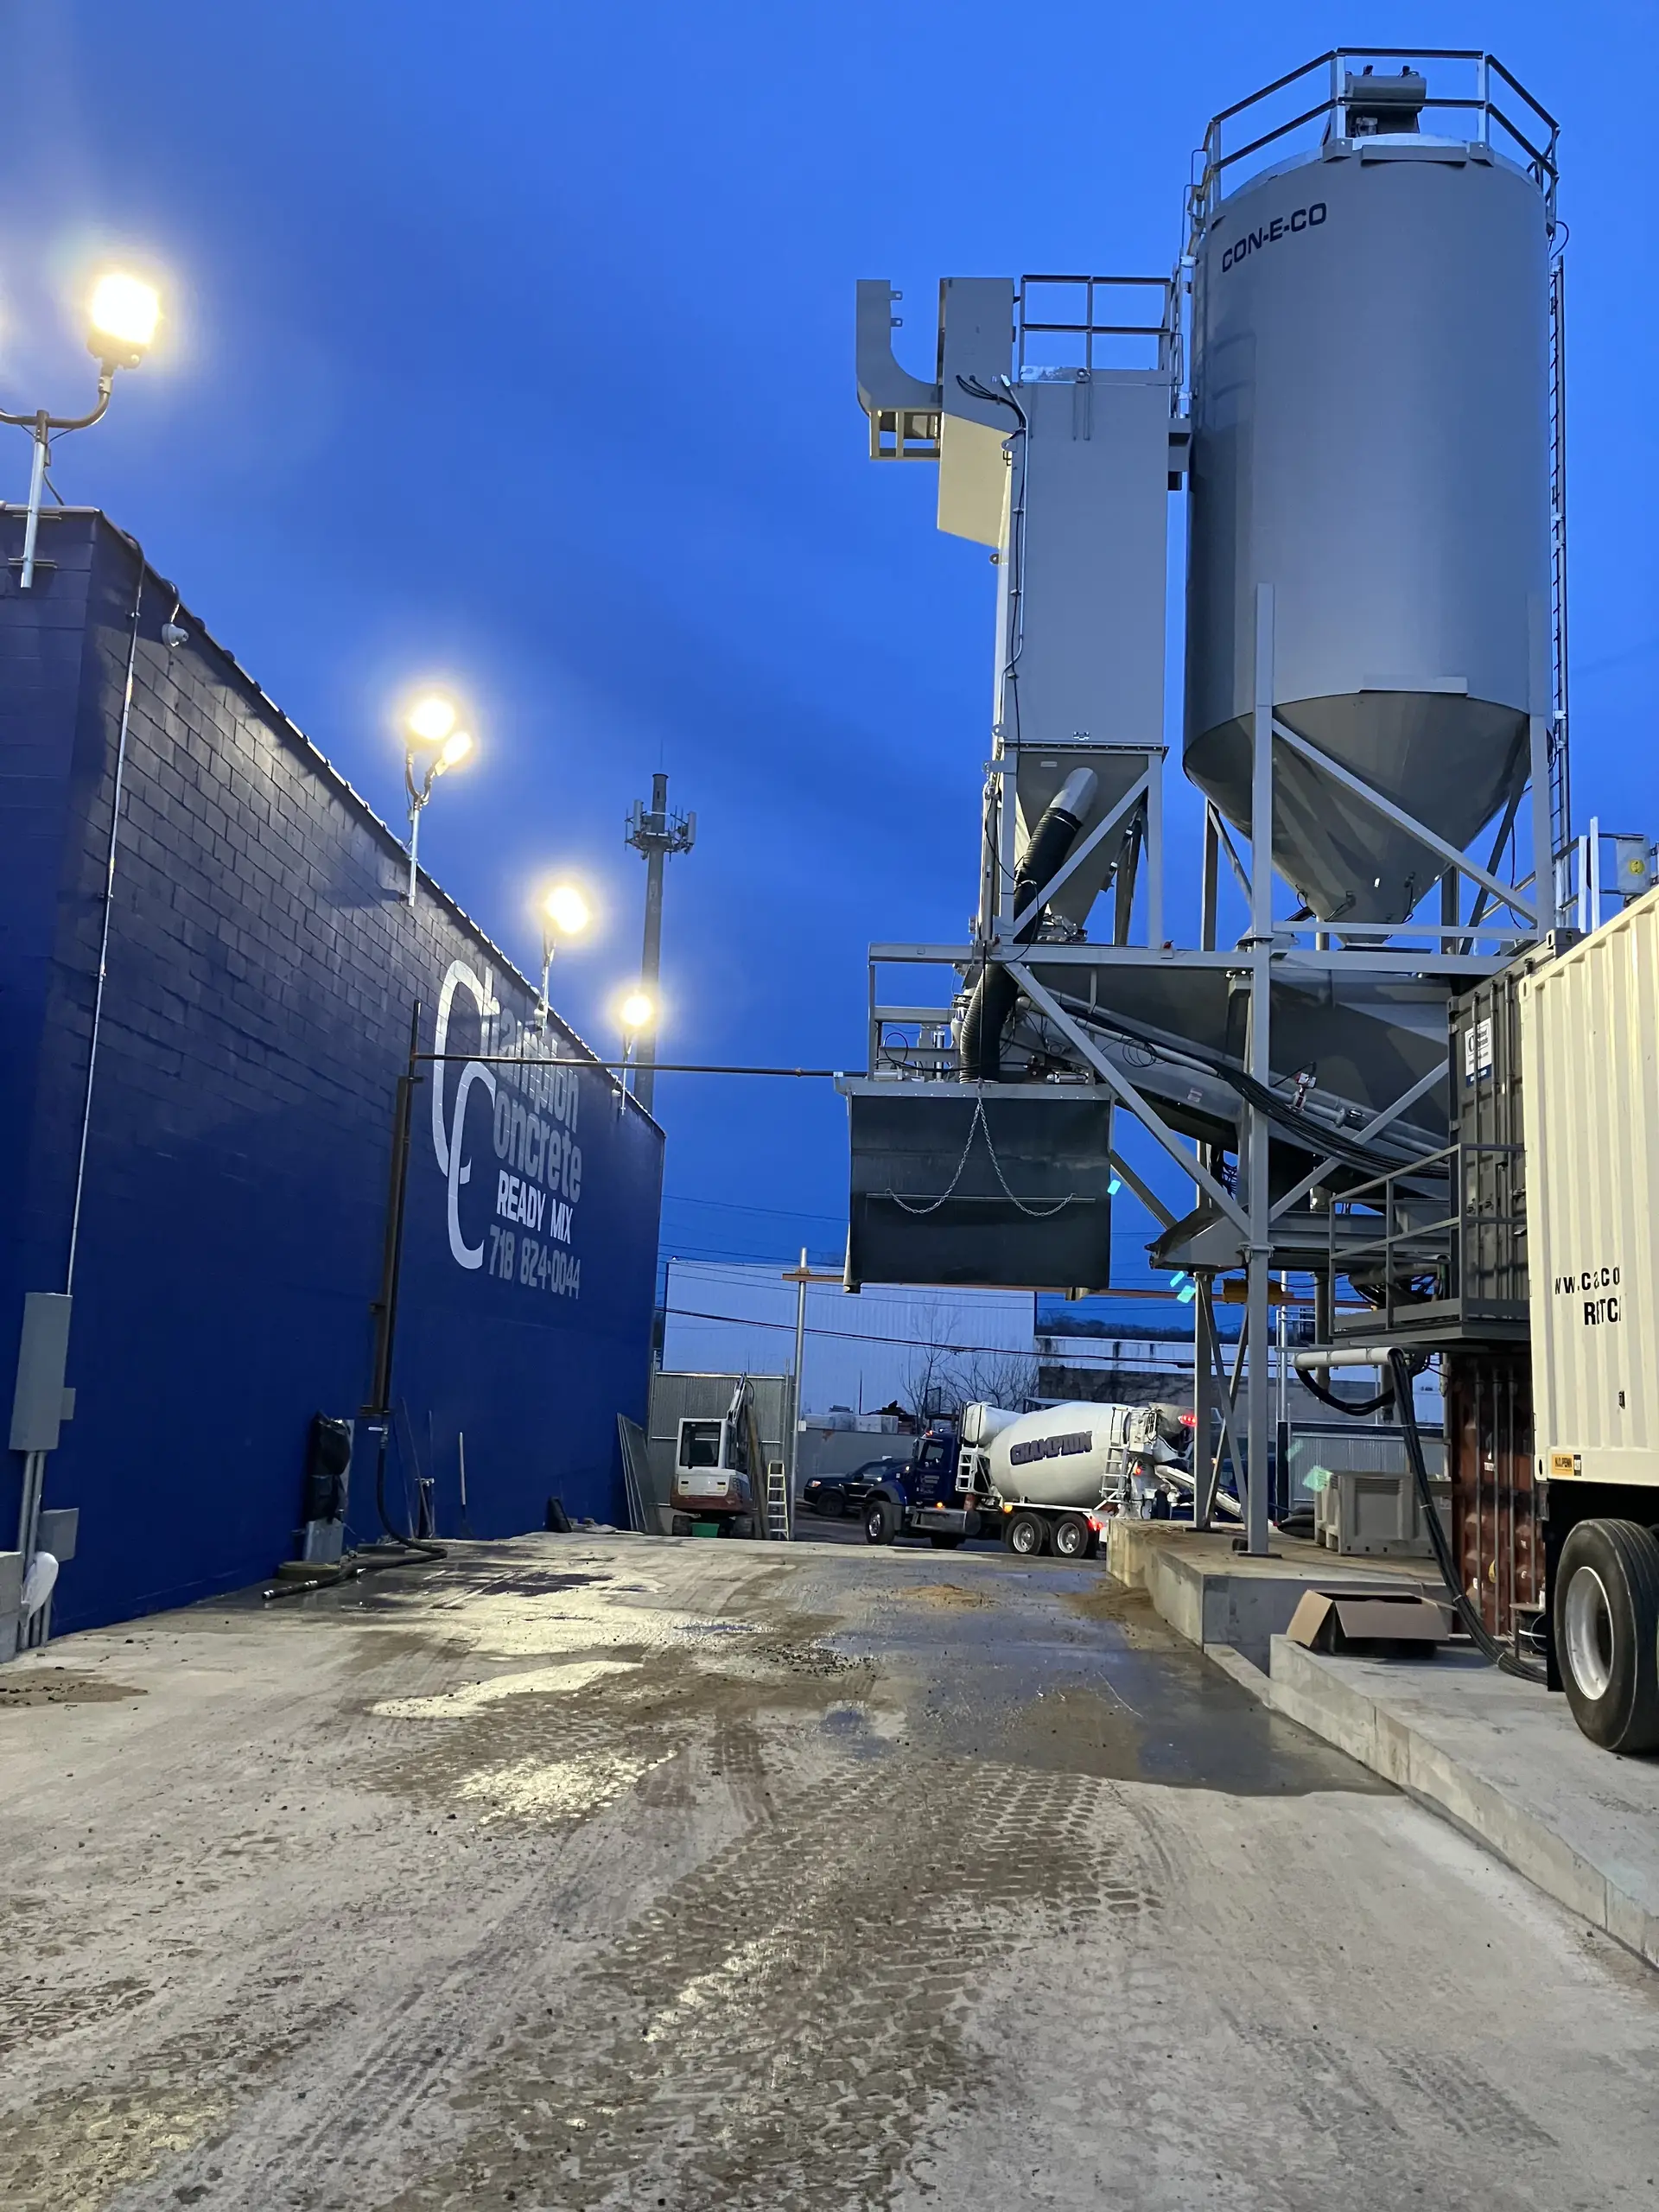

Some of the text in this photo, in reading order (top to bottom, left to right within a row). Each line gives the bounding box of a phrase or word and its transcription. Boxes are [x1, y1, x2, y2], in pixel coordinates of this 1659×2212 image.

[1222, 202, 1327, 273] CON-E-CO
[448, 1061, 582, 1269] Concrete
[496, 1169, 573, 1244] READY MIX
[488, 1224, 581, 1300] 718 824-0044
[1010, 1431, 1093, 1465] CHAMPION
